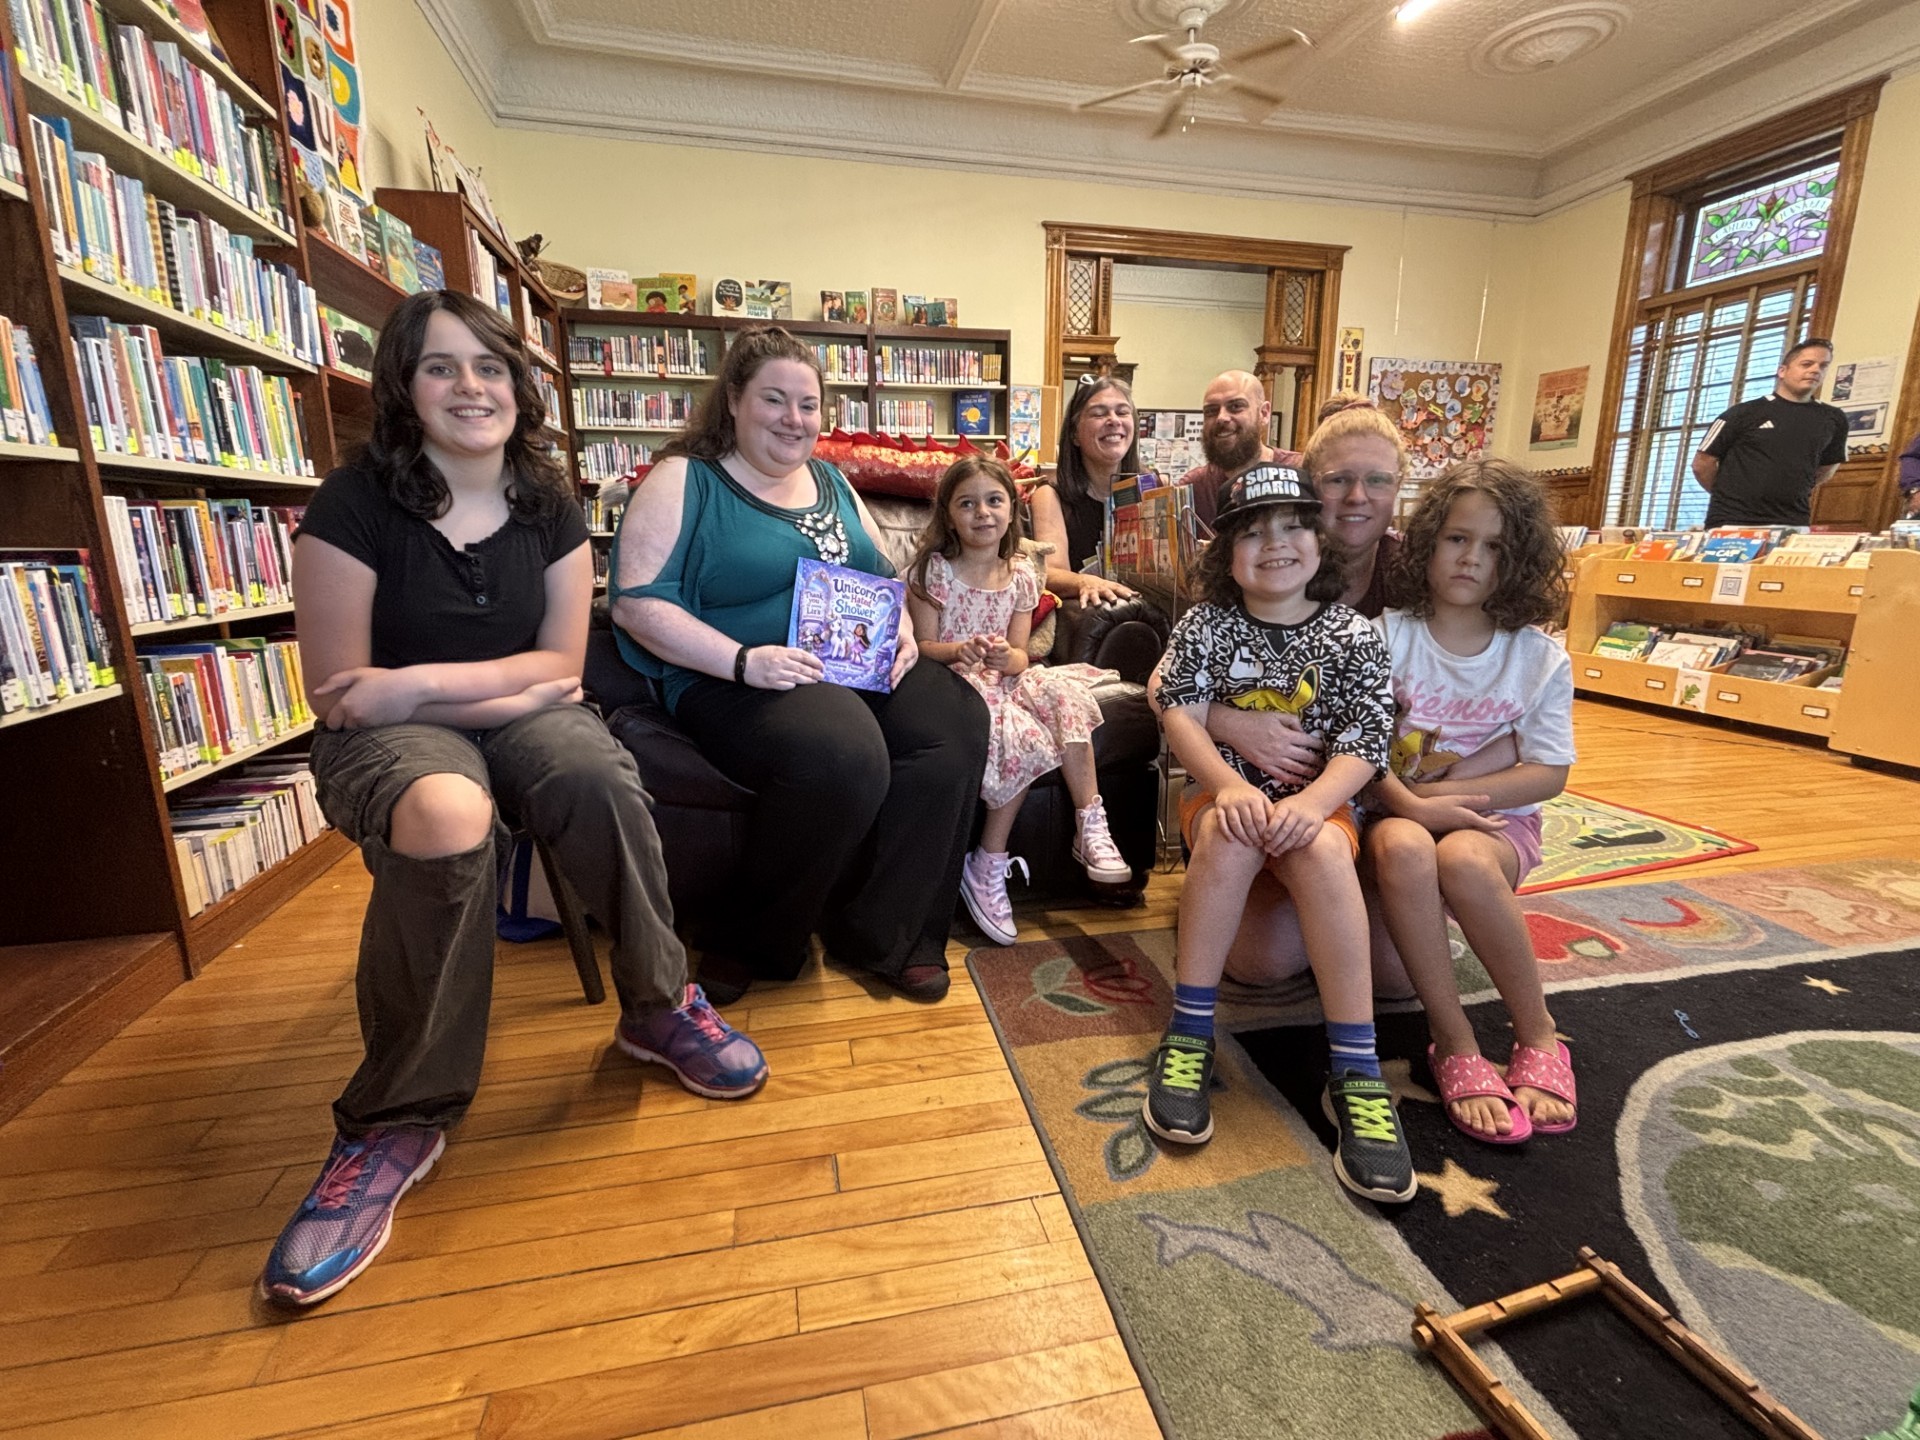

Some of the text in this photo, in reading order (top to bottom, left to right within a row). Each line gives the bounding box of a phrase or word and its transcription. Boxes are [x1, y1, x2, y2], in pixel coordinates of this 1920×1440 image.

[1246, 467, 1299, 485] SUPER
[1246, 480, 1300, 500] MARIO
[805, 591, 824, 601] Thank
[833, 578, 877, 601] Unicorn
[835, 598, 876, 618] Shower
[851, 594, 872, 608] Hated
